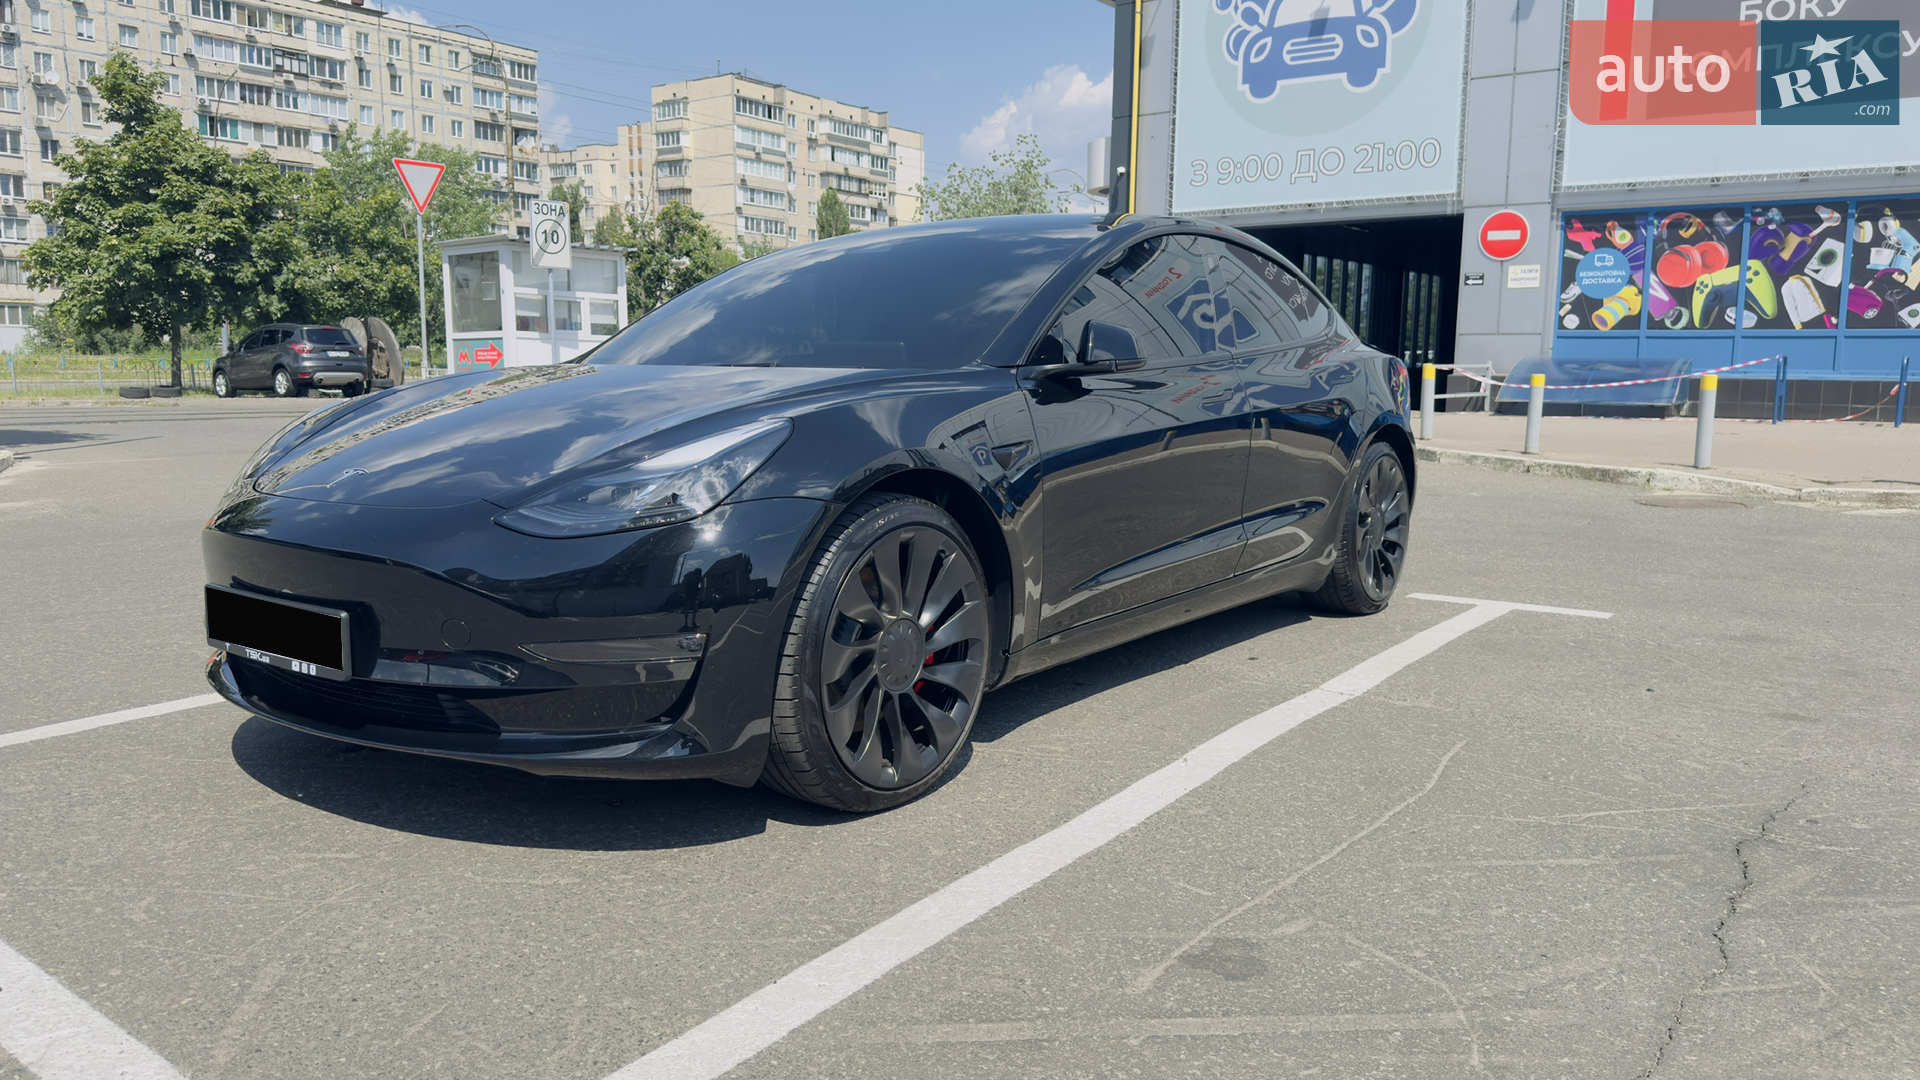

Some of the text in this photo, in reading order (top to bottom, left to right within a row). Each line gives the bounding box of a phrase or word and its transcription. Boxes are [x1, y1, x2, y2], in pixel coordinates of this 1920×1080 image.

[1739, 0, 1847, 27] БОКУ
[1216, 152, 1284, 186] 9:00
[1289, 147, 1345, 185] ДО
[1353, 137, 1442, 174] 21:00
[533, 202, 566, 217] ЗОНА
[541, 228, 559, 245] 10
[1579, 269, 1626, 277] БЕЗКОШТОВНА
[1582, 277, 1622, 285] ДОСТАВКА
